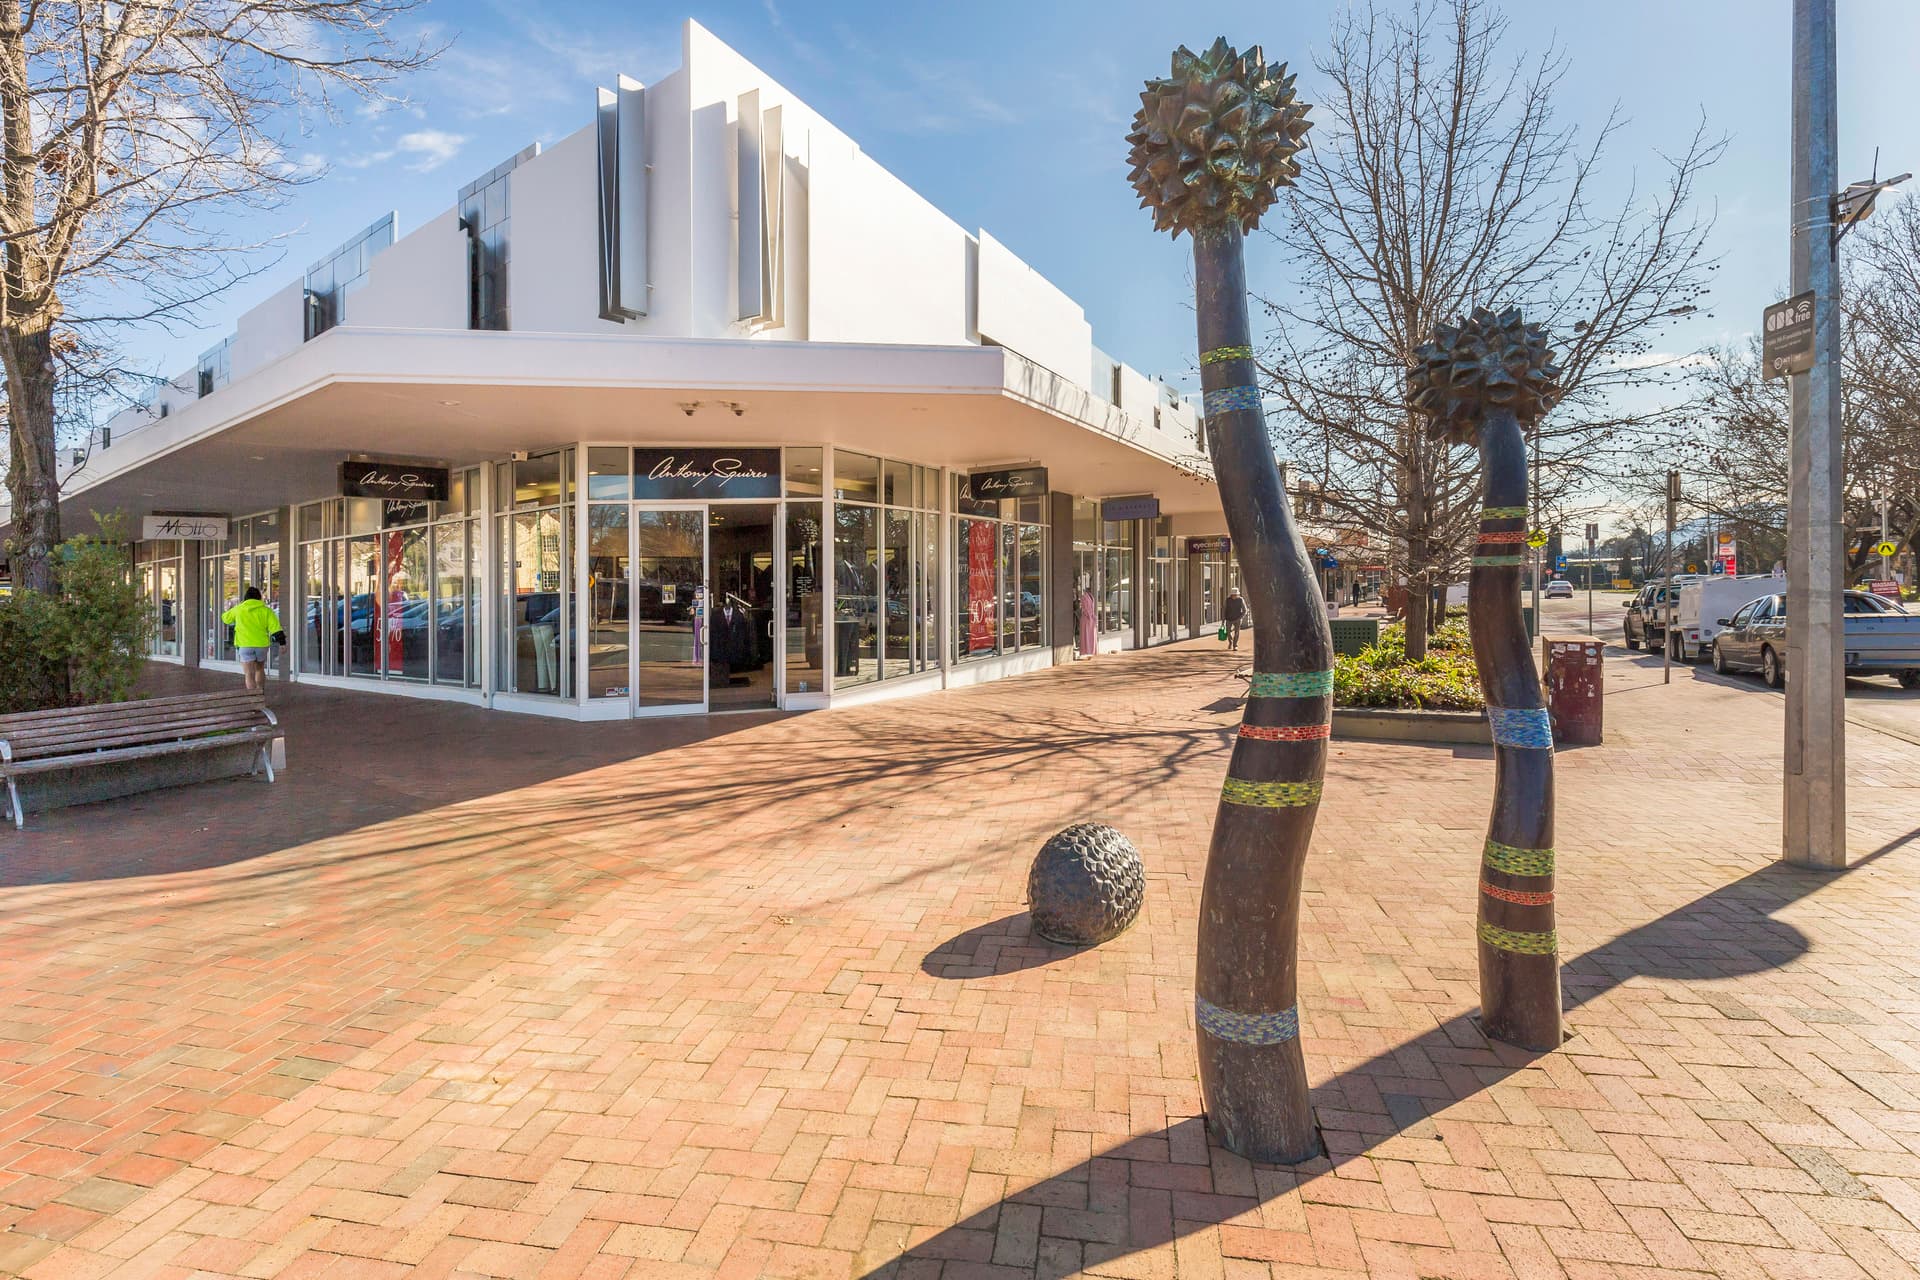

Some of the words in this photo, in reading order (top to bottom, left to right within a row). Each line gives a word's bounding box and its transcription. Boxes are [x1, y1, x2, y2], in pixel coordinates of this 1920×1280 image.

[1766, 308, 1795, 331] CBR
[359, 470, 401, 491] Anthony
[400, 474, 435, 492] Squires
[648, 456, 713, 488] Anthony
[712, 458, 768, 488] Squires
[981, 477, 1009, 493] Anthony
